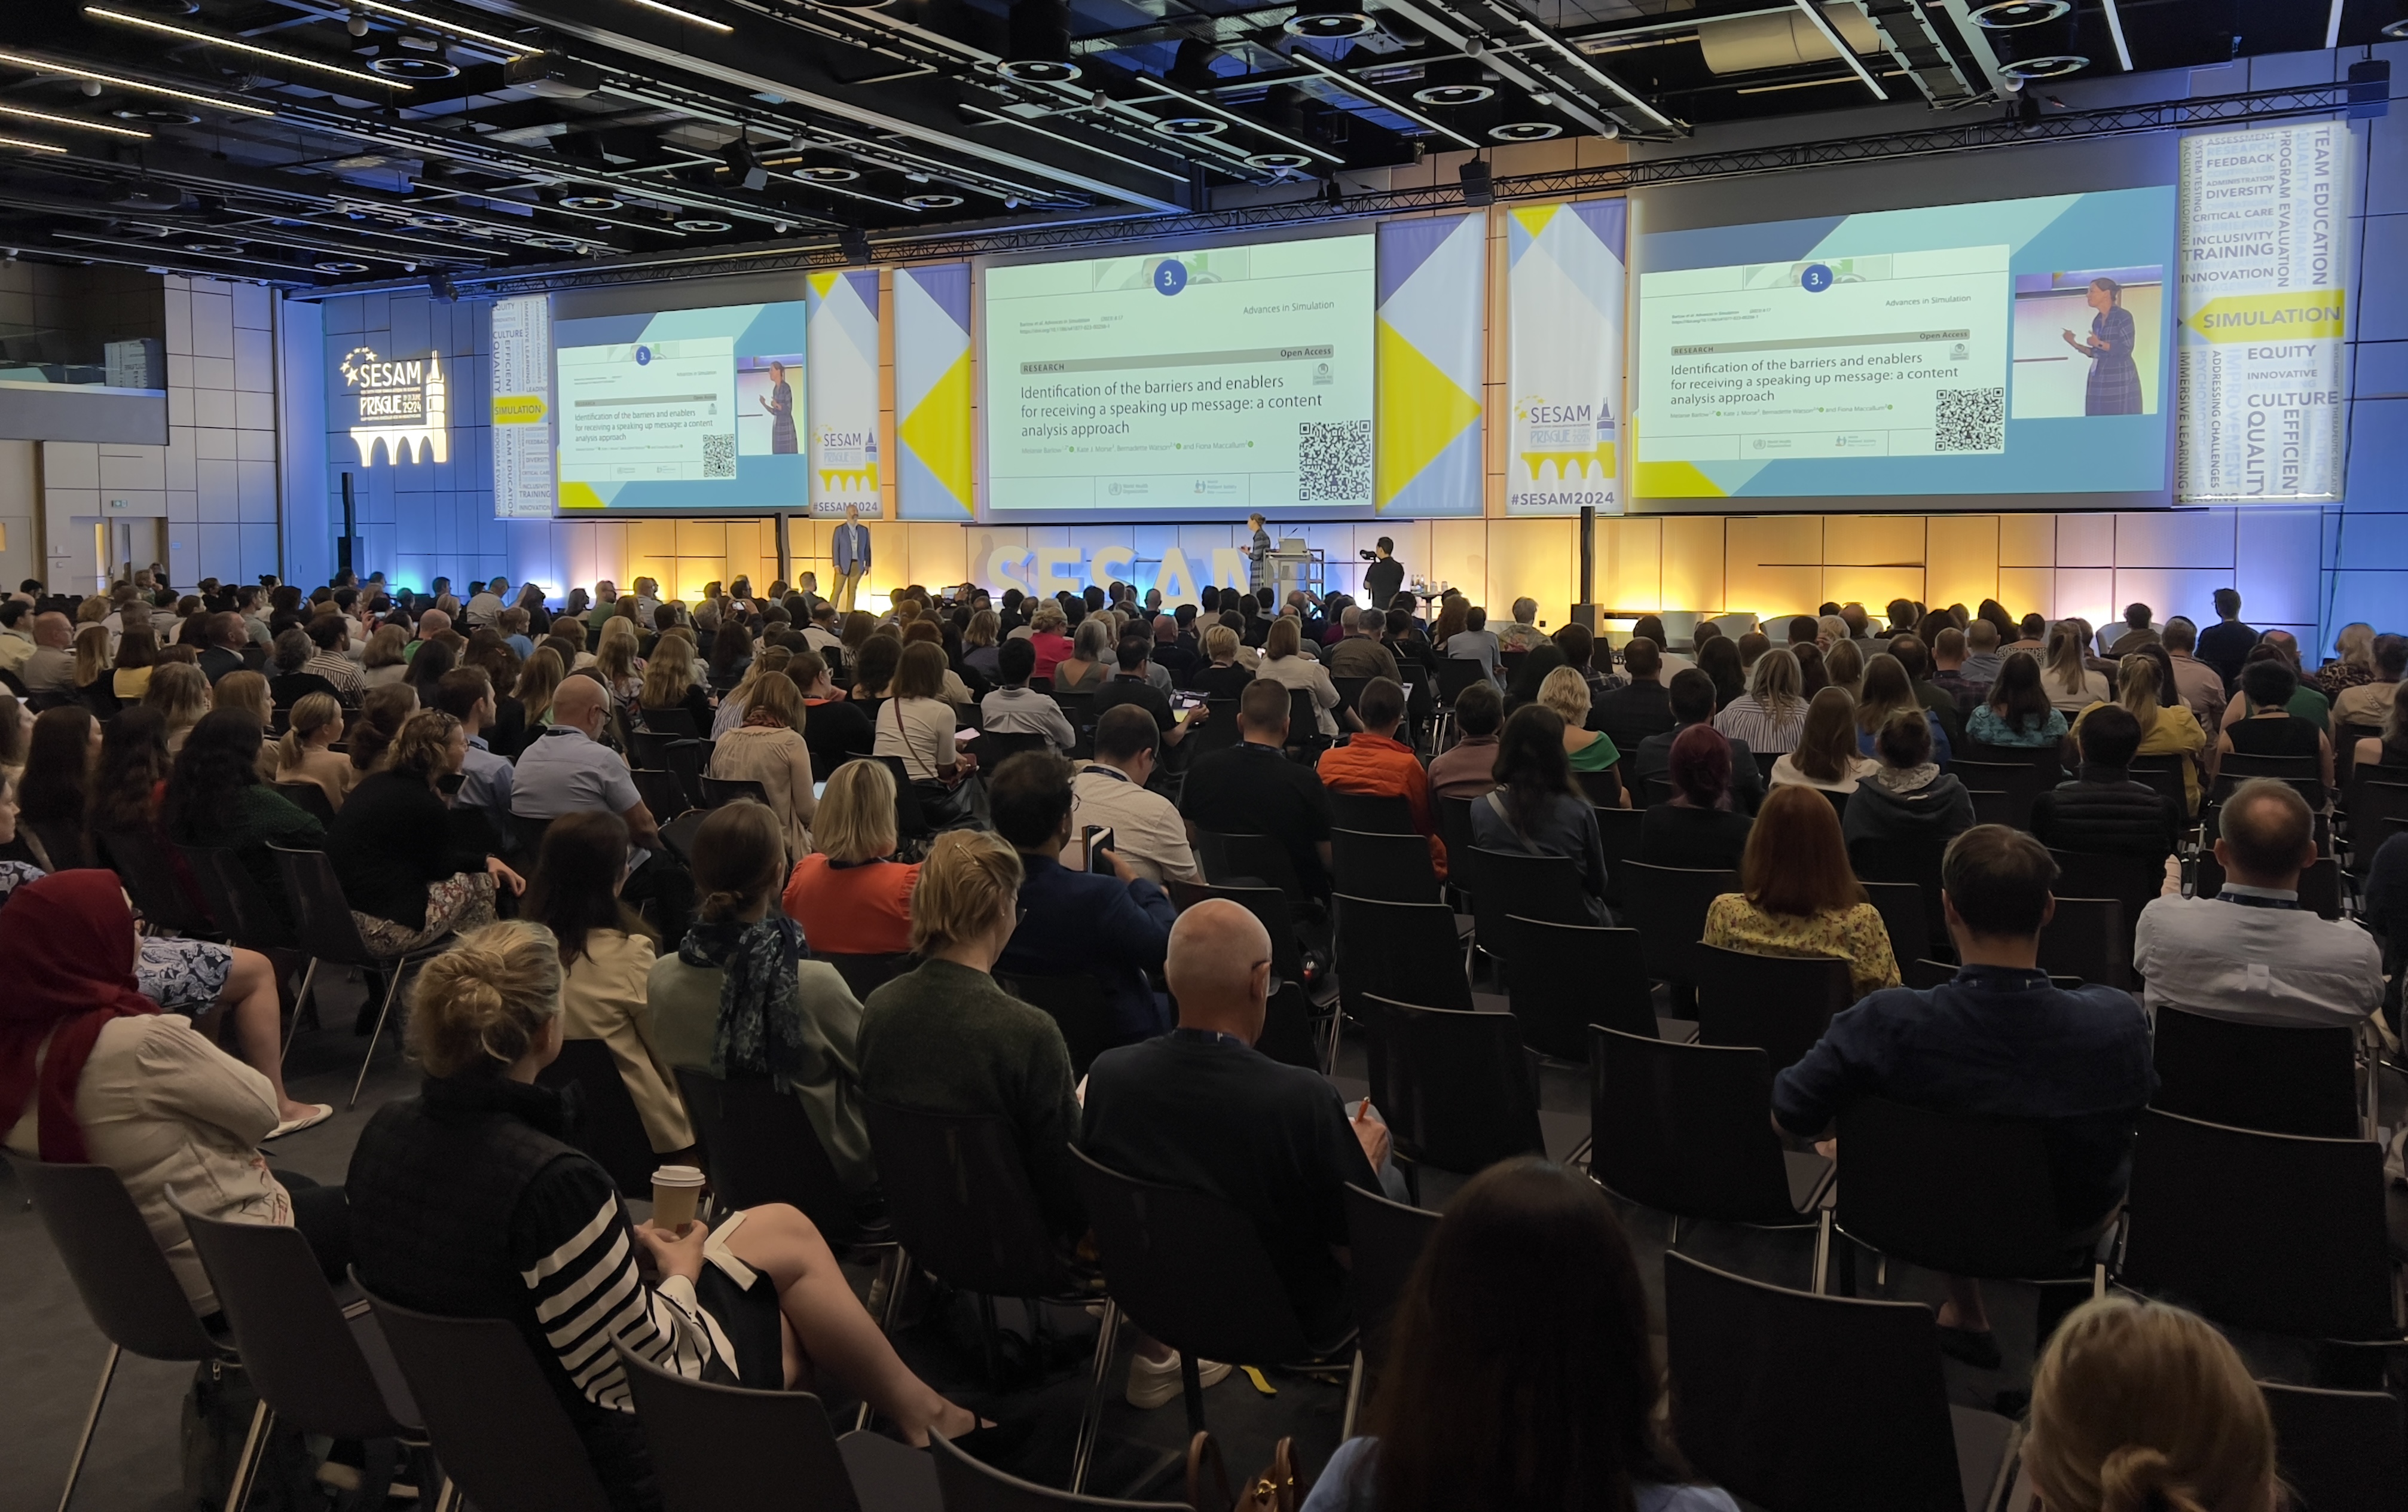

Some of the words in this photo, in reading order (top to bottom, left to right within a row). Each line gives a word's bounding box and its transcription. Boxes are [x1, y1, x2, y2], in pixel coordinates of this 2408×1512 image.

[2207, 132, 2275, 145] ASSESSMENT
[2183, 141, 2191, 178] FACULTY
[2195, 140, 2203, 173] SYSTEM
[2314, 126, 2330, 176] TEAM
[2207, 154, 2275, 167] FEEDBACK
[2279, 130, 2291, 198] PROGRAM
[2296, 129, 2310, 191] QUALITY
[2207, 175, 2275, 187] ADMINISTRATION
[2194, 176, 2202, 212] TESTING
[2207, 185, 2274, 199] DIVERSITY
[2182, 181, 2190, 246] DEVELOPMENT
[2193, 211, 2241, 222] CRITICAL
[2245, 208, 2274, 218] CARE
[2193, 231, 2273, 246] INCLUSIVITY
[2294, 198, 2308, 286] ASSURANCE
[2312, 182, 2328, 285] EDUCATION
[2183, 243, 2273, 261] TRAINING
[2277, 203, 2291, 287] EVALUATION
[1164, 271, 1177, 286] 3.
[1811, 273, 1823, 285] 3.
[2181, 268, 2273, 283] INNOVATION
[493, 303, 515, 311] QUITY
[1243, 306, 1280, 314] Advances
[1292, 301, 1334, 311] Simulation
[1932, 295, 1972, 304] Simulation
[2204, 306, 2341, 329] SIMULATION
[493, 329, 524, 339] CULTURE
[640, 352, 647, 361] 3.
[1281, 350, 1302, 358] Open
[1304, 347, 1331, 356] Access
[2248, 345, 2317, 359] EQUITY
[1023, 364, 1065, 372] RESEARCH
[1671, 362, 1748, 375] Identification
[1752, 360, 1764, 371] of
[1767, 359, 1786, 370] the
[1790, 357, 1836, 369] barriers
[1840, 355, 1864, 366] and
[1868, 353, 1923, 365] enablers
[360, 361, 421, 388] SESAM
[1671, 380, 1686, 390] for
[1690, 378, 1743, 390] receiving
[1756, 374, 1811, 389] speaking
[1815, 374, 1831, 385] up
[1835, 371, 1893, 383] message:
[1897, 371, 1903, 380] a
[1908, 368, 1958, 379] content
[2247, 369, 2318, 380] INNOVATIVE
[1021, 384, 1101, 399] Identification
[1105, 381, 1117, 395] of
[1121, 381, 1141, 395] the
[1145, 379, 1193, 393] barriers
[1197, 377, 1221, 392] and
[1226, 375, 1284, 389] enablers
[2179, 352, 2190, 420] IMMERSIVE
[2211, 350, 2221, 417] ADDRESSING
[360, 395, 401, 416] PRAGUE
[402, 401, 421, 413] 2024
[1671, 393, 1715, 406] analysis
[1718, 390, 1774, 405] approach
[2248, 391, 2338, 407] CULTURE
[494, 405, 541, 415] SIMULATION
[1021, 405, 1038, 418] for
[1041, 404, 1095, 419] receiving
[1099, 405, 1106, 415] a
[1110, 400, 1166, 417] speaking
[1171, 402, 1187, 415] up
[1192, 399, 1253, 413] message:
[1257, 399, 1264, 408] a
[1268, 395, 1322, 408] content
[1531, 405, 1590, 423] SESAM
[575, 413, 613, 421] Identification
[2224, 349, 2242, 488] IMPROVEMENT
[584, 423, 610, 432] receiving
[616, 423, 643, 431] speaking
[1022, 423, 1068, 439] analysis
[1071, 420, 1129, 438] approach
[575, 435, 598, 443] analysis
[599, 433, 627, 442] approach
[824, 433, 861, 447] SESAM
[1530, 429, 1570, 444] PRAGUE
[2178, 425, 2189, 488] LEARNING
[2210, 421, 2221, 488] CHALLENGES
[2246, 411, 2266, 500] QUALITY
[2282, 409, 2300, 500] EFFICIENT
[1511, 491, 1614, 505] #SESAM2024
